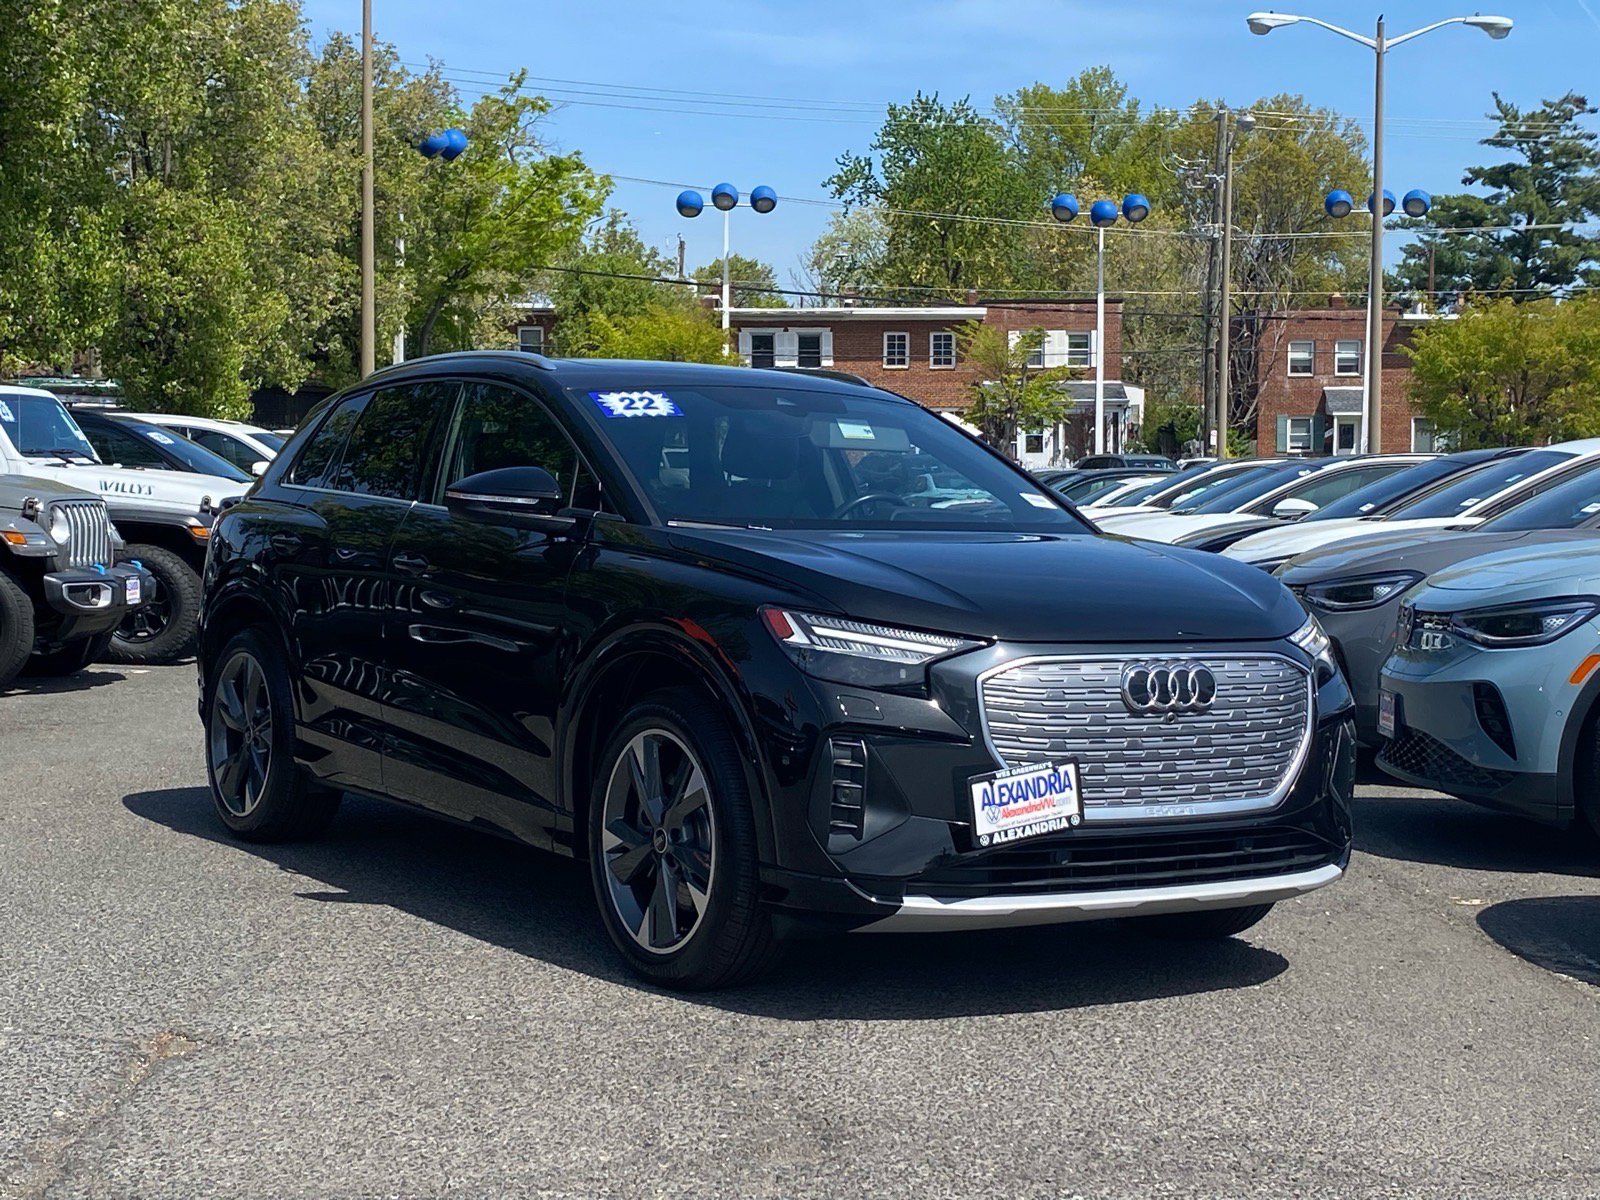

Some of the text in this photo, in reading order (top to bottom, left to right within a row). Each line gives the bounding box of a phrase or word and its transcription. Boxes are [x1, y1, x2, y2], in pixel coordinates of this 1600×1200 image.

[618, 397, 659, 410] 22
[100, 480, 155, 495] WILLYS
[981, 770, 1073, 811] ALEXANDRIA
[992, 817, 1070, 844] ALEXANDRIA
